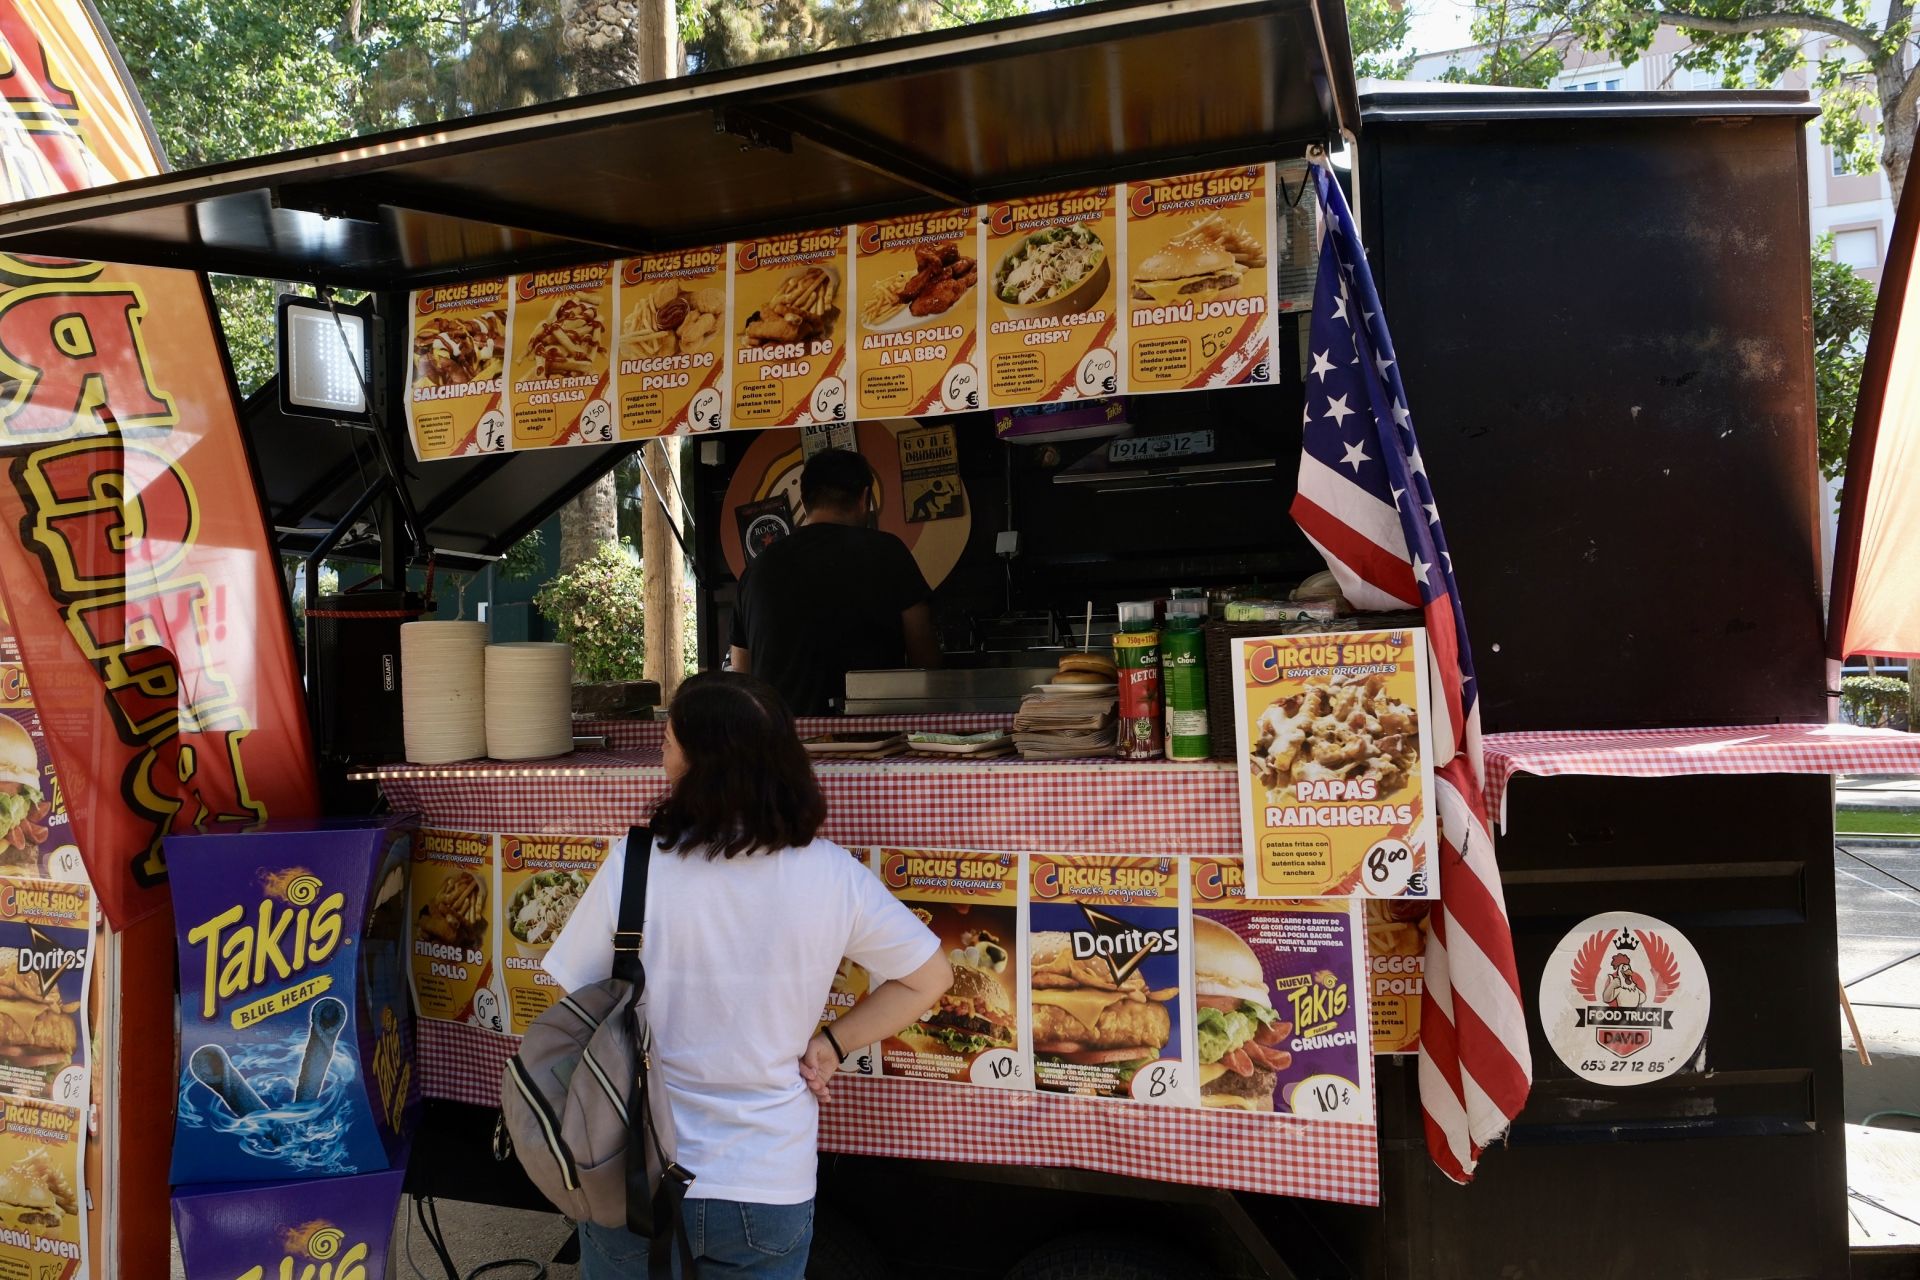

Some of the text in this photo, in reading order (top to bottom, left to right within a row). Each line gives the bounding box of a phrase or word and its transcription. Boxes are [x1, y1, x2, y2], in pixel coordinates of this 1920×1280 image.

[1130, 176, 1256, 216] CIRCUS SHOP
[990, 196, 1107, 234] CIRCUS SHOP
[860, 216, 968, 254] CIRCUS SHOP
[738, 236, 839, 270] CIRCUS SHOP
[624, 252, 720, 284] CIRCUS SHOP
[518, 267, 607, 300] CIRCUS SHOP
[418, 282, 502, 314] CIRCUS SHOP
[862, 325, 964, 350] ALITAS POLLO
[1024, 330, 1072, 346] CRISPY
[880, 346, 947, 366] A LA BBQ
[642, 374, 689, 390] POLLO
[760, 362, 810, 380] POLLO
[414, 379, 502, 402] SALCHIPAPAS
[515, 374, 599, 393] PATATAS FRITAS
[552, 390, 586, 402] SALSA
[1250, 644, 1402, 683] CIRCUS SHOP
[1288, 664, 1396, 678] SNACKS ORIGINALES
[1297, 778, 1378, 802] PAPAS
[456, 840, 486, 856] SHOP
[504, 840, 600, 870] CIRCUS SHOP
[1294, 840, 1314, 848] fritas
[885, 854, 1008, 888] CIRCUS SHOP
[1034, 862, 1168, 898] CIRCUS SHOP
[914, 878, 1002, 890] SNACKS ORIGINALES
[52, 892, 84, 912] SHOP
[188, 892, 344, 1018] Takis
[1073, 929, 1178, 958] Doritos
[20, 948, 84, 972] Doritos
[431, 962, 467, 980] POLLO
[1279, 976, 1310, 988] NUEVA
[239, 982, 316, 1024] BLUE HEAT
[1288, 984, 1347, 1036] Takis
[1588, 1010, 1660, 1022] FOOD TRUCK
[1291, 1031, 1356, 1052] CRUNCH
[1604, 1031, 1644, 1045] DAVID
[1581, 1060, 1664, 1072] 653 27 12 85
[42, 1110, 74, 1129] SHOP
